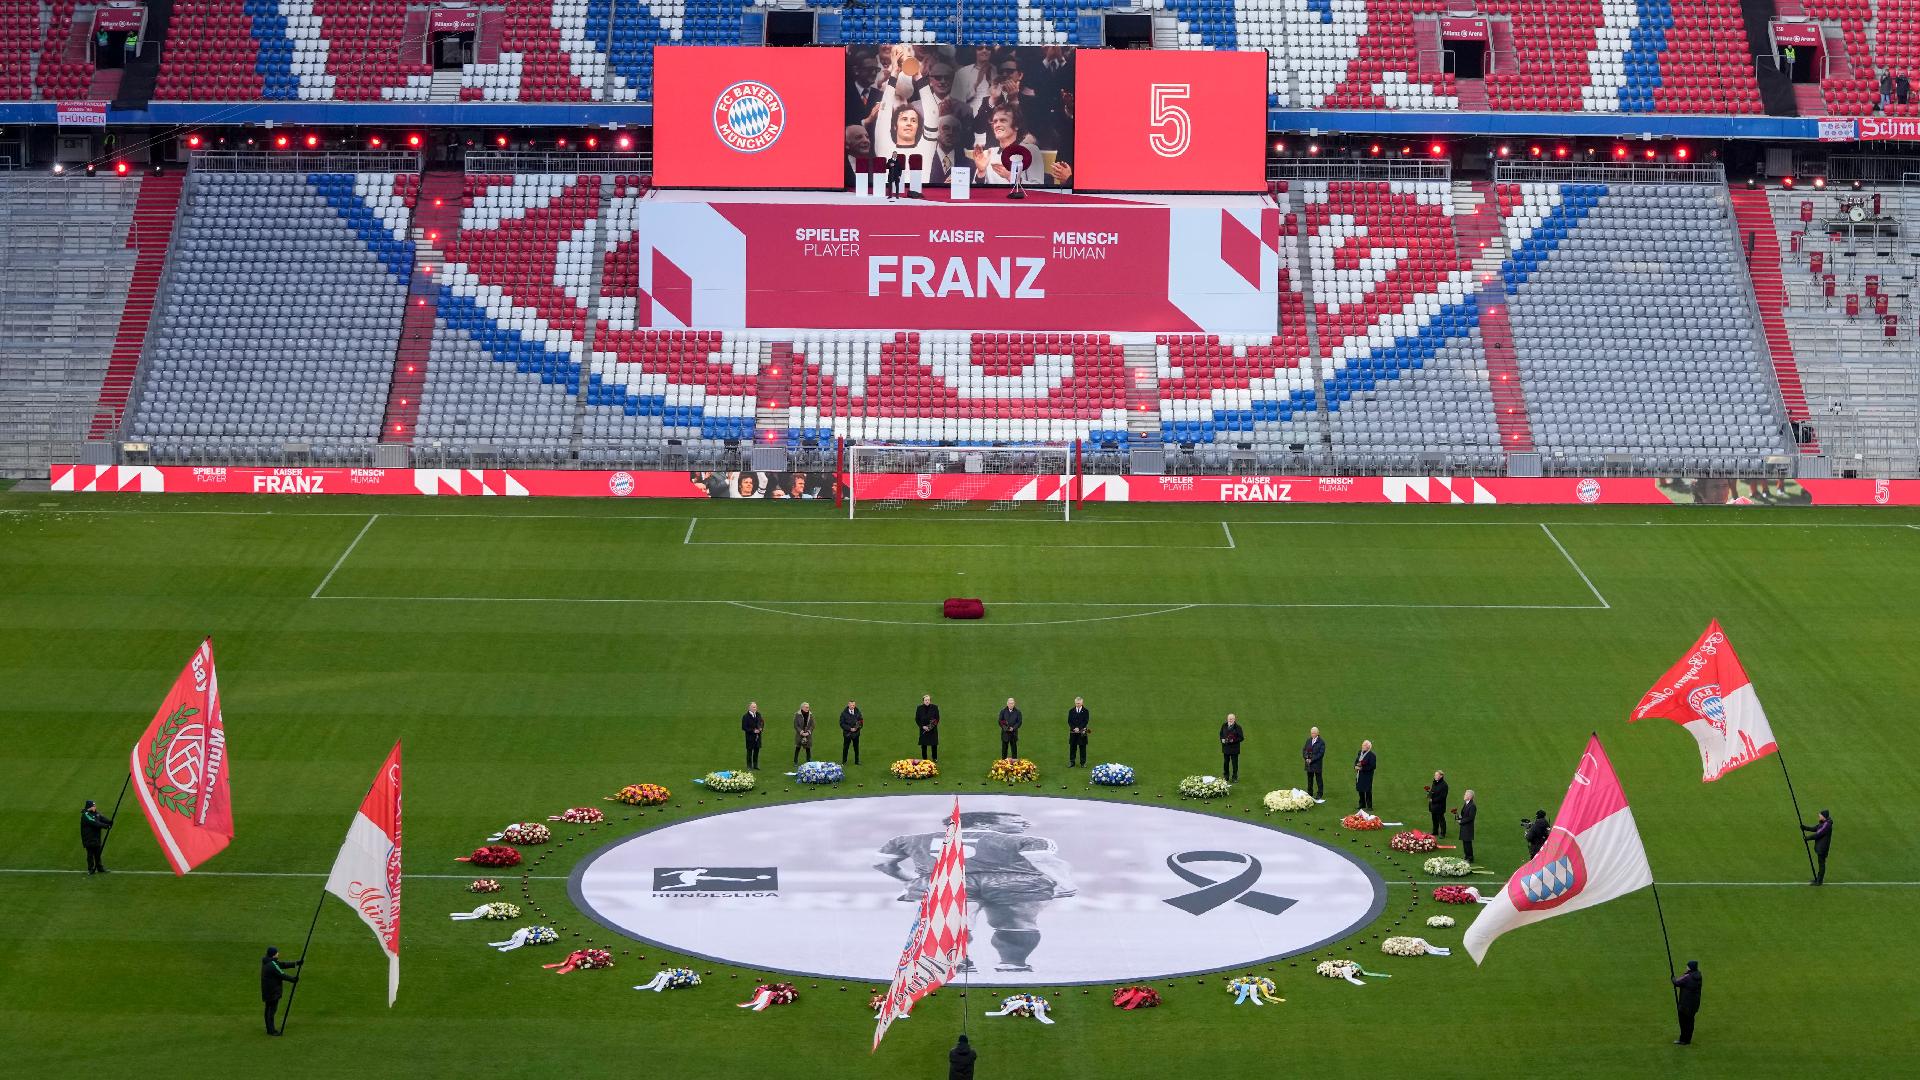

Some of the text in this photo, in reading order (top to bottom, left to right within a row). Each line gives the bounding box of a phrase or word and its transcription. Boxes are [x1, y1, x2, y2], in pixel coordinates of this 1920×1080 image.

[719, 85, 780, 112] FC BAYERN
[60, 113, 105, 123] THÜNGEN
[1149, 83, 1191, 158] 5
[719, 123, 779, 149] MÜNCHEN
[795, 228, 860, 242] SPIELER
[929, 229, 985, 243] KAISER
[1053, 231, 1119, 245] MENSCH
[804, 243, 860, 257] PLAYER
[1052, 246, 1106, 260] HUMAN
[868, 255, 1046, 298] FRANZ
[351, 469, 385, 477] MENSCH
[1159, 476, 1194, 484] SPIELER
[1241, 476, 1271, 484] KAISER
[253, 476, 324, 493] FRANZ
[916, 473, 932, 498] 5
[1163, 483, 1194, 491] PLAYER
[1319, 477, 1353, 485] MENSCH
[1319, 484, 1348, 492] HUMAN
[1220, 484, 1292, 501] FRANZ
[1875, 479, 1890, 504] 5
